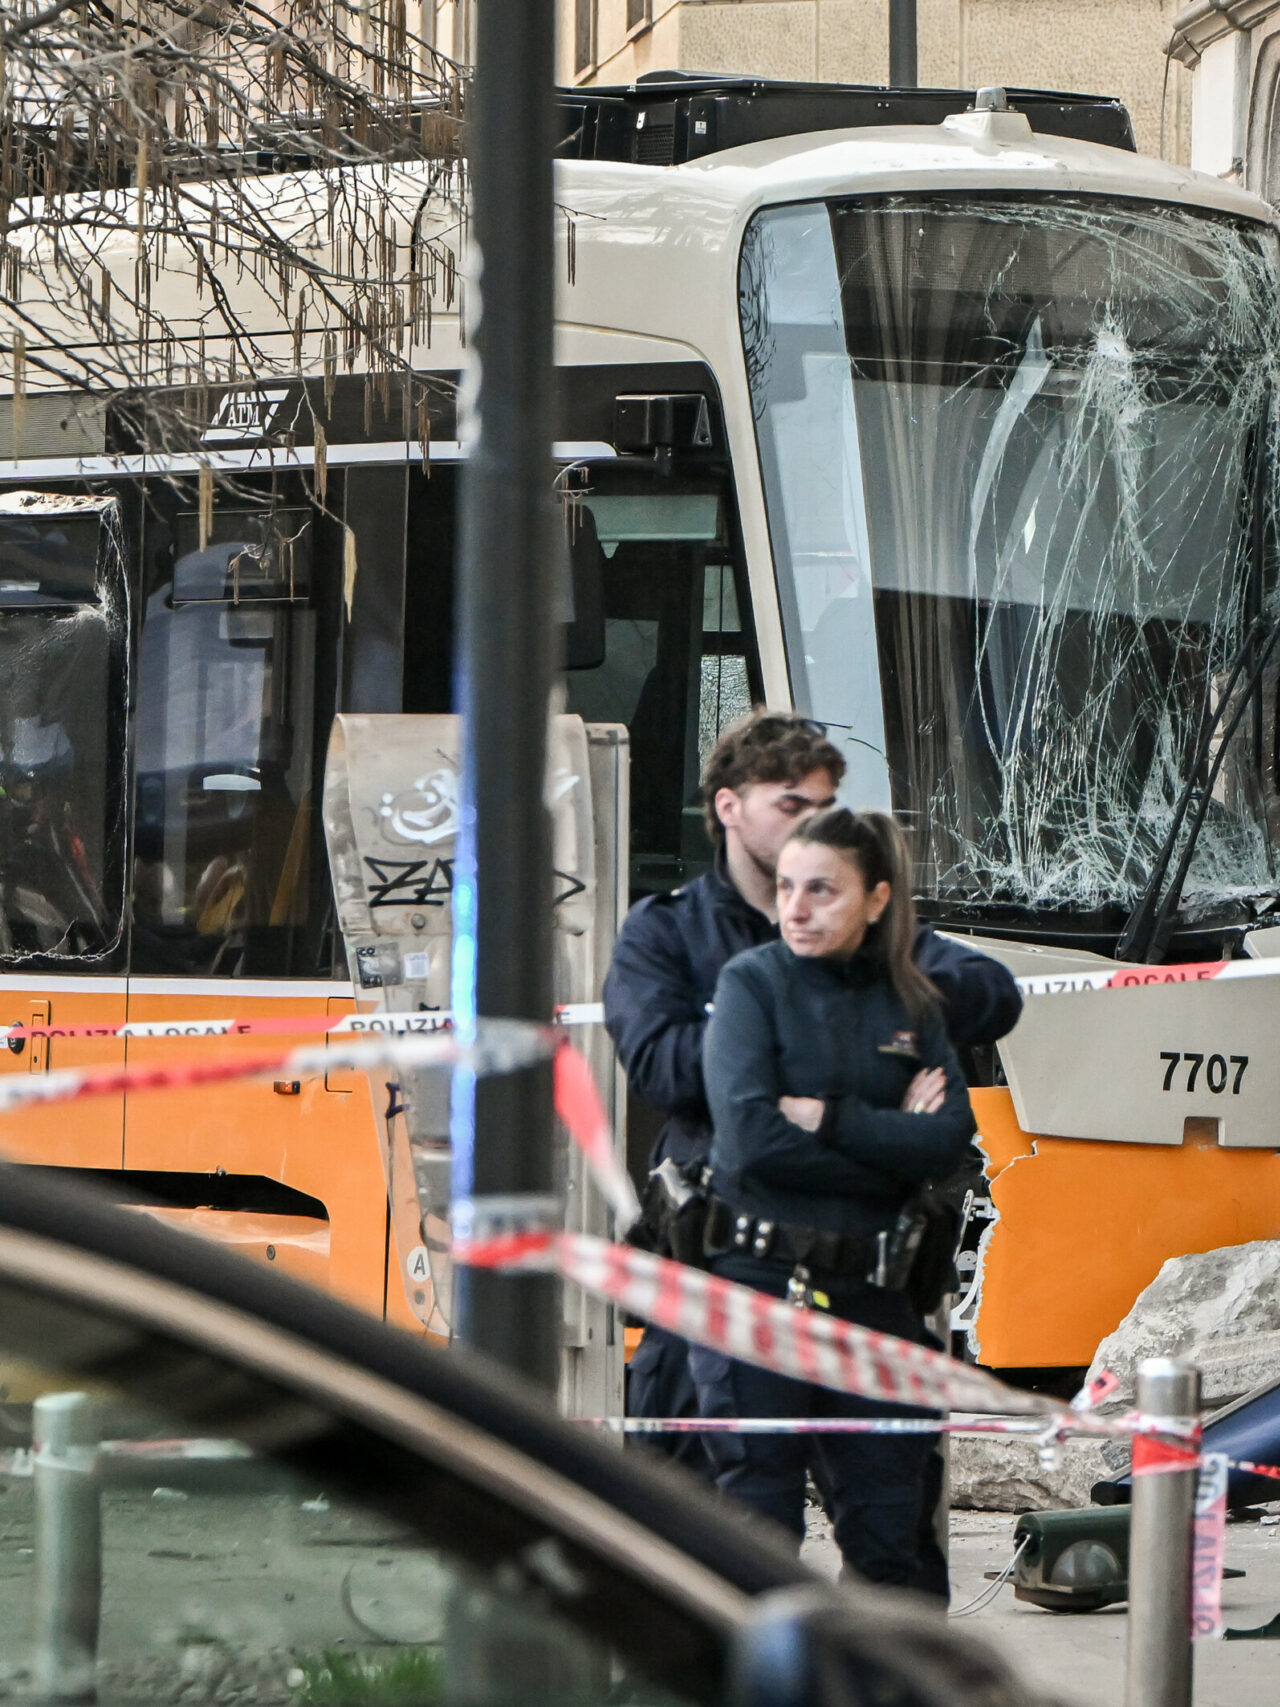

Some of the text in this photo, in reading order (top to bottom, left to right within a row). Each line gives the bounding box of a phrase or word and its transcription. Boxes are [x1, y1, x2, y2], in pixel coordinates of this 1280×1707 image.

[226, 402, 261, 428] ATM
[1160, 1052, 1249, 1094] 7707
[413, 1253, 426, 1275] A
